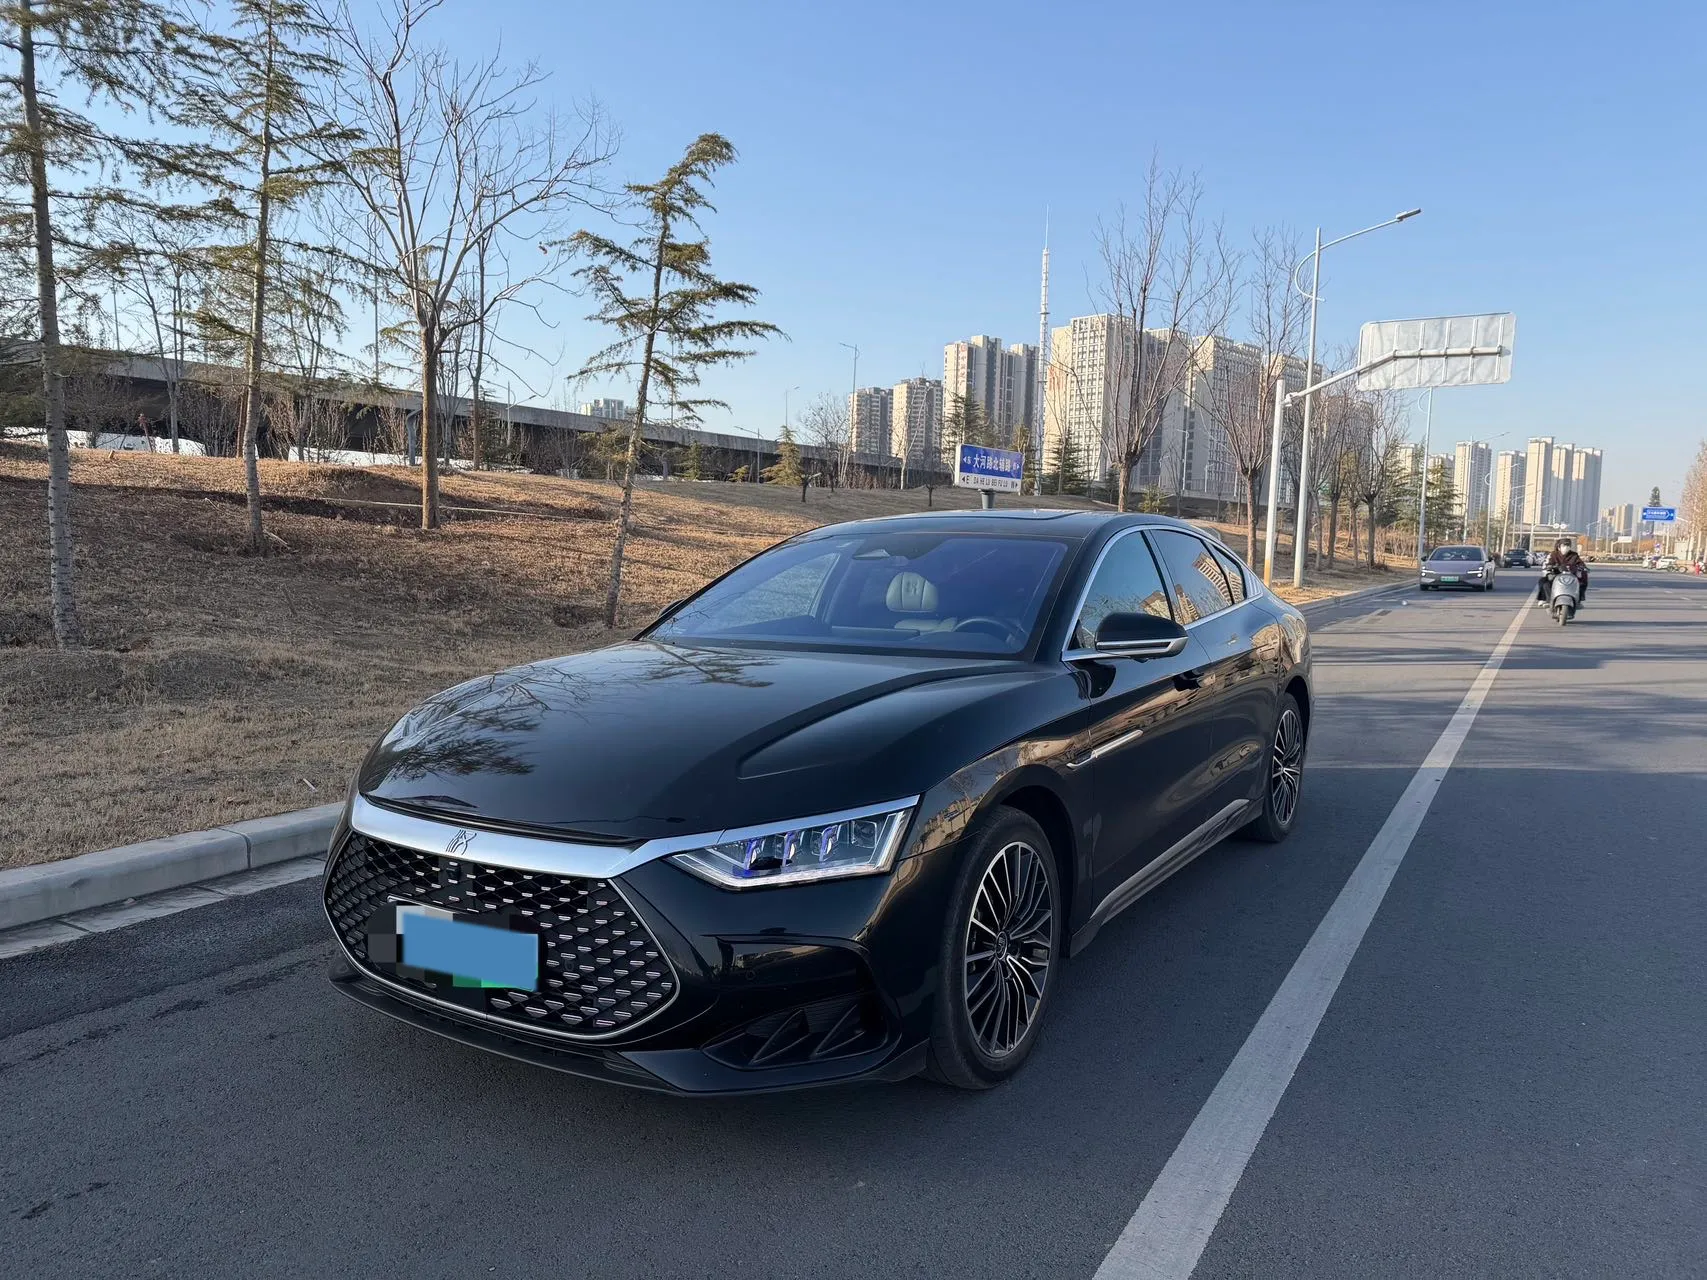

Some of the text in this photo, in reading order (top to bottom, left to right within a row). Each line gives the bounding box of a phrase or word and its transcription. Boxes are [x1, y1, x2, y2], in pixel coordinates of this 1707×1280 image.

[972, 454, 1011, 472] 大河路北辅路
